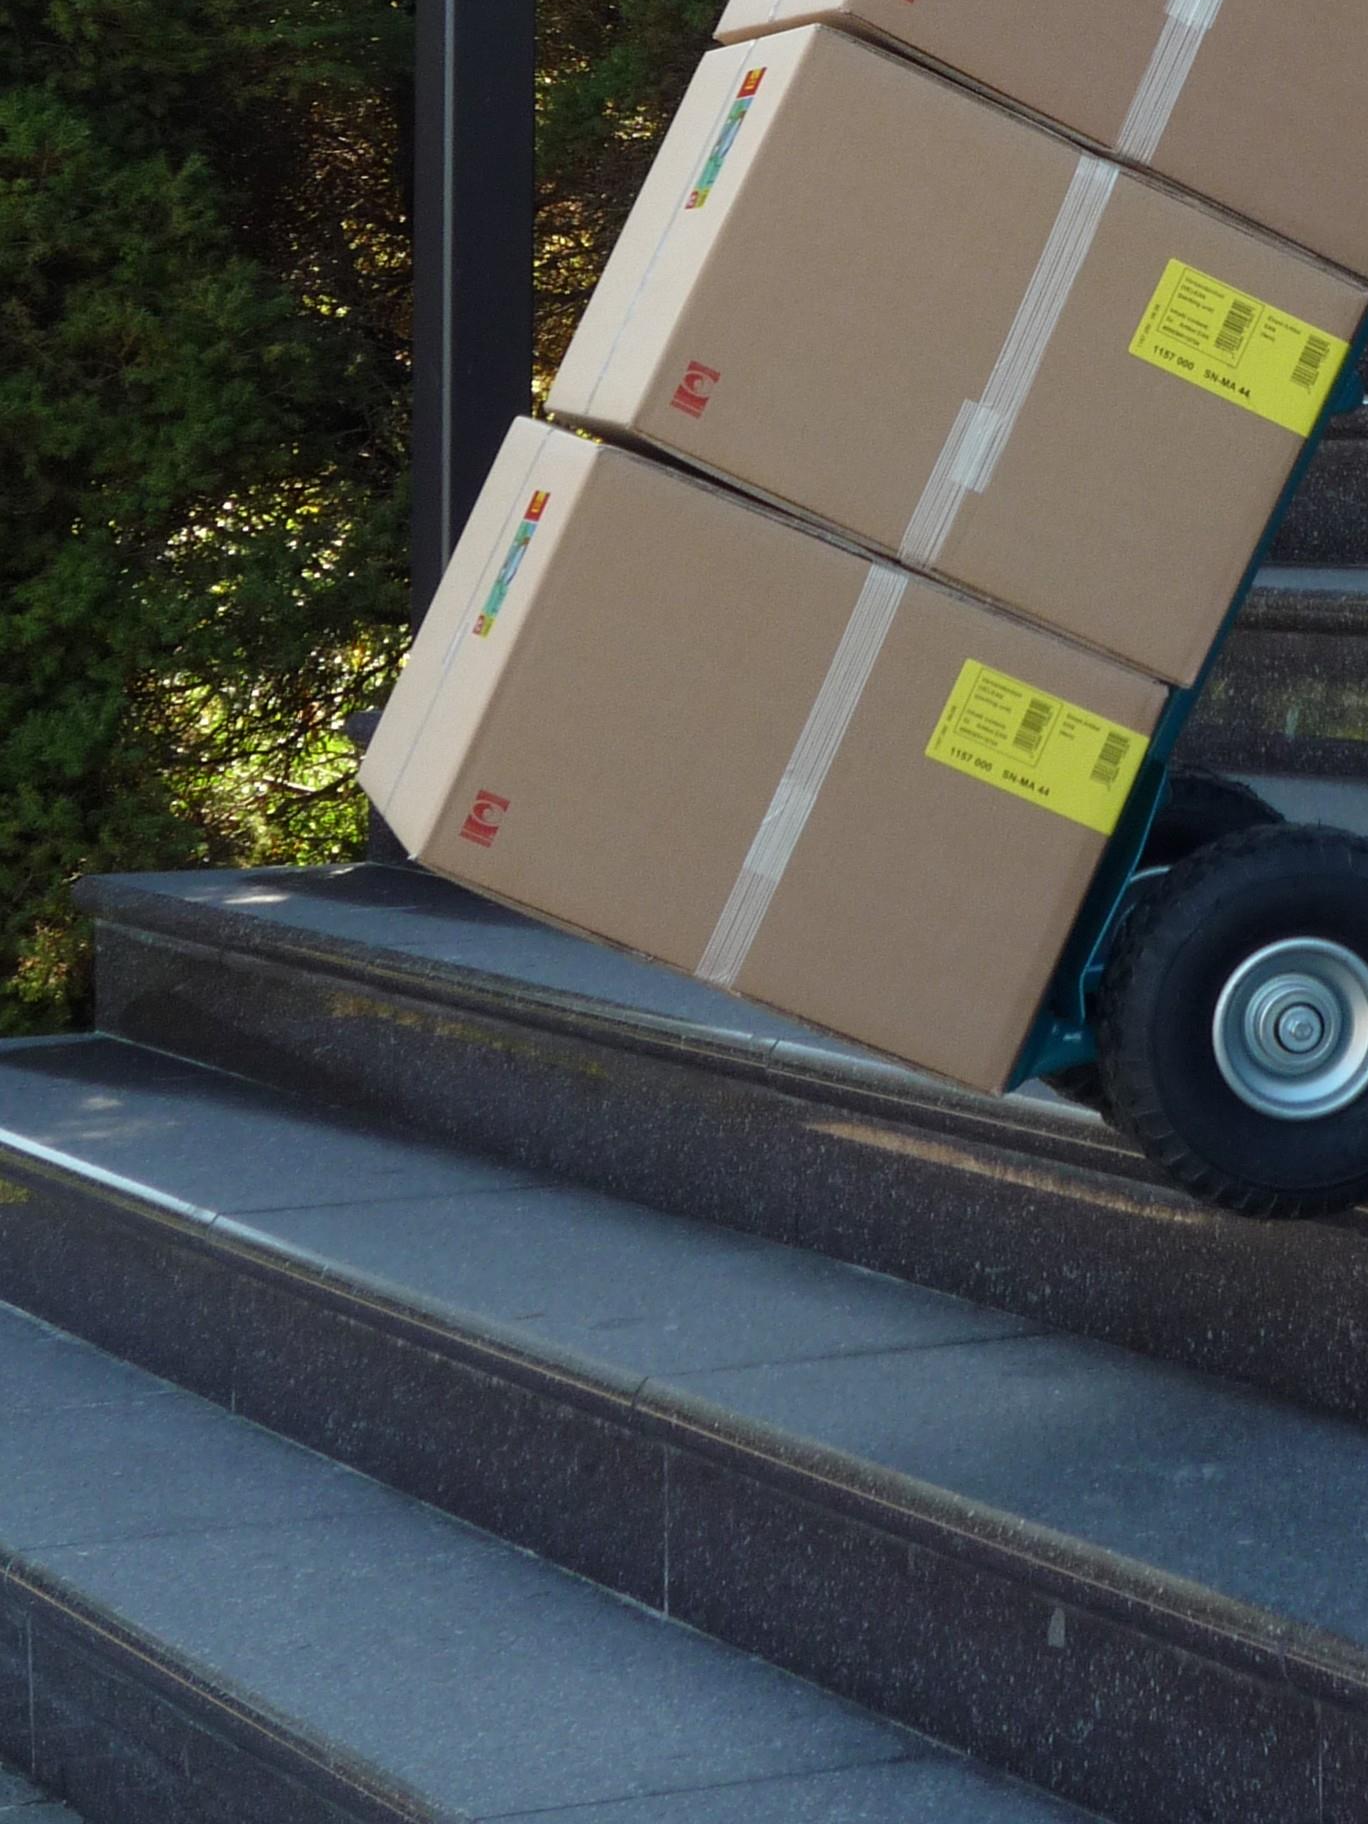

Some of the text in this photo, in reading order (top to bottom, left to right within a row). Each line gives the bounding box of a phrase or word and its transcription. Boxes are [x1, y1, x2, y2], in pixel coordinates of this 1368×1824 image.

[1153, 344, 1175, 361] 1157
[1176, 356, 1195, 371] 000
[951, 746, 973, 763] 1157
[974, 758, 993, 773] 000
